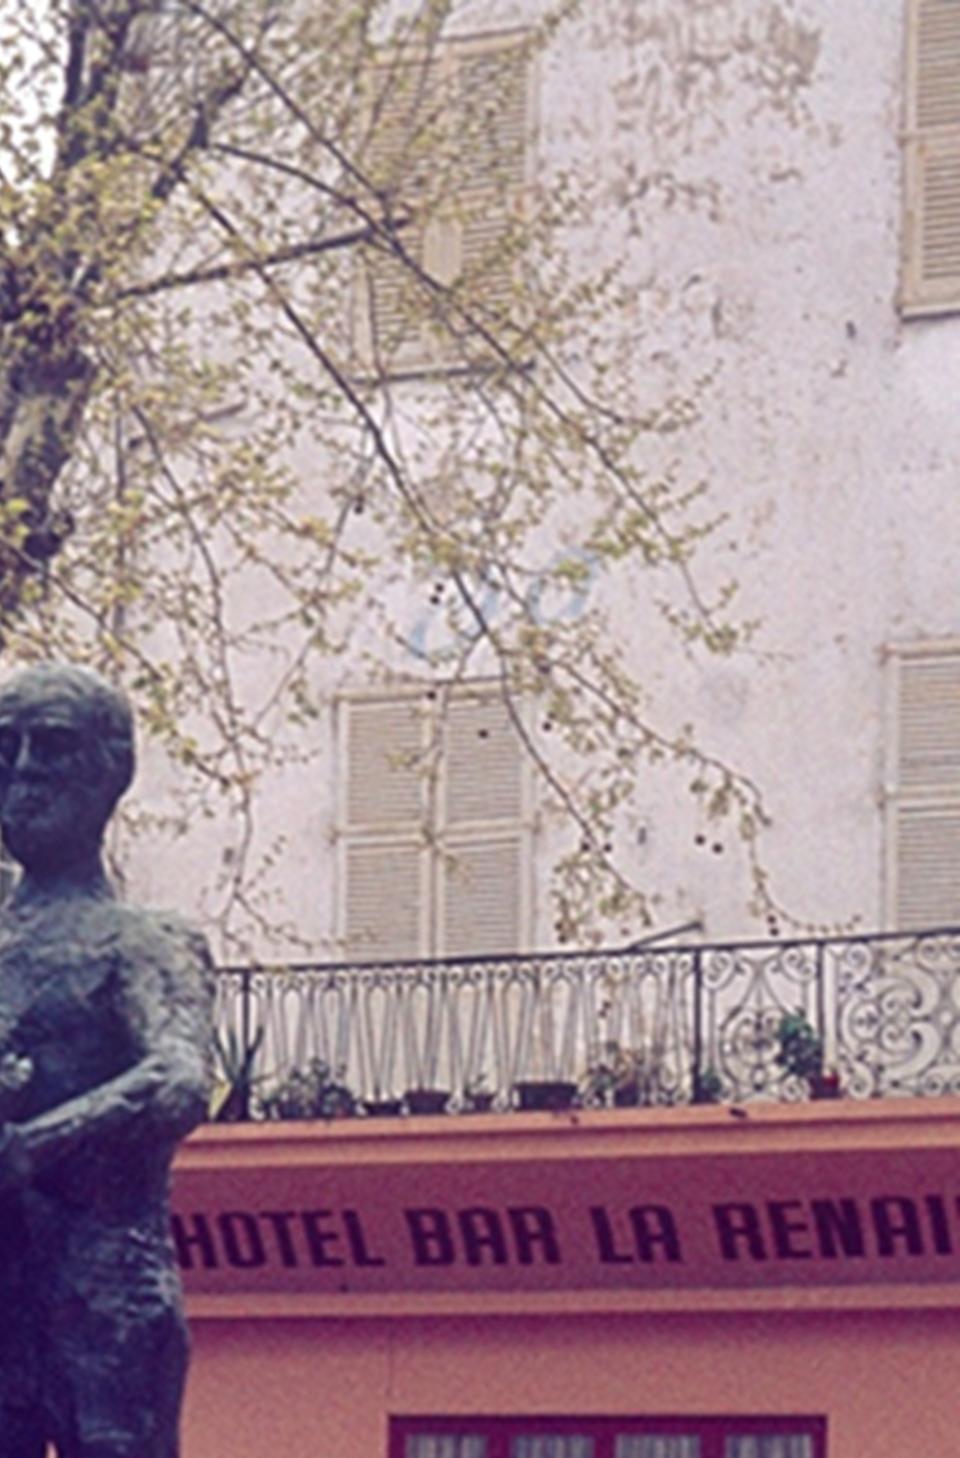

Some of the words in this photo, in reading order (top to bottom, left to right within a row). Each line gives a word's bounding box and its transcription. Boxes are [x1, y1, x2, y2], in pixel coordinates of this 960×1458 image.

[171, 1209, 385, 1269] HOTEL
[404, 1207, 561, 1265] BAR
[590, 1203, 681, 1264] LA
[713, 1194, 960, 1262] RENAI
